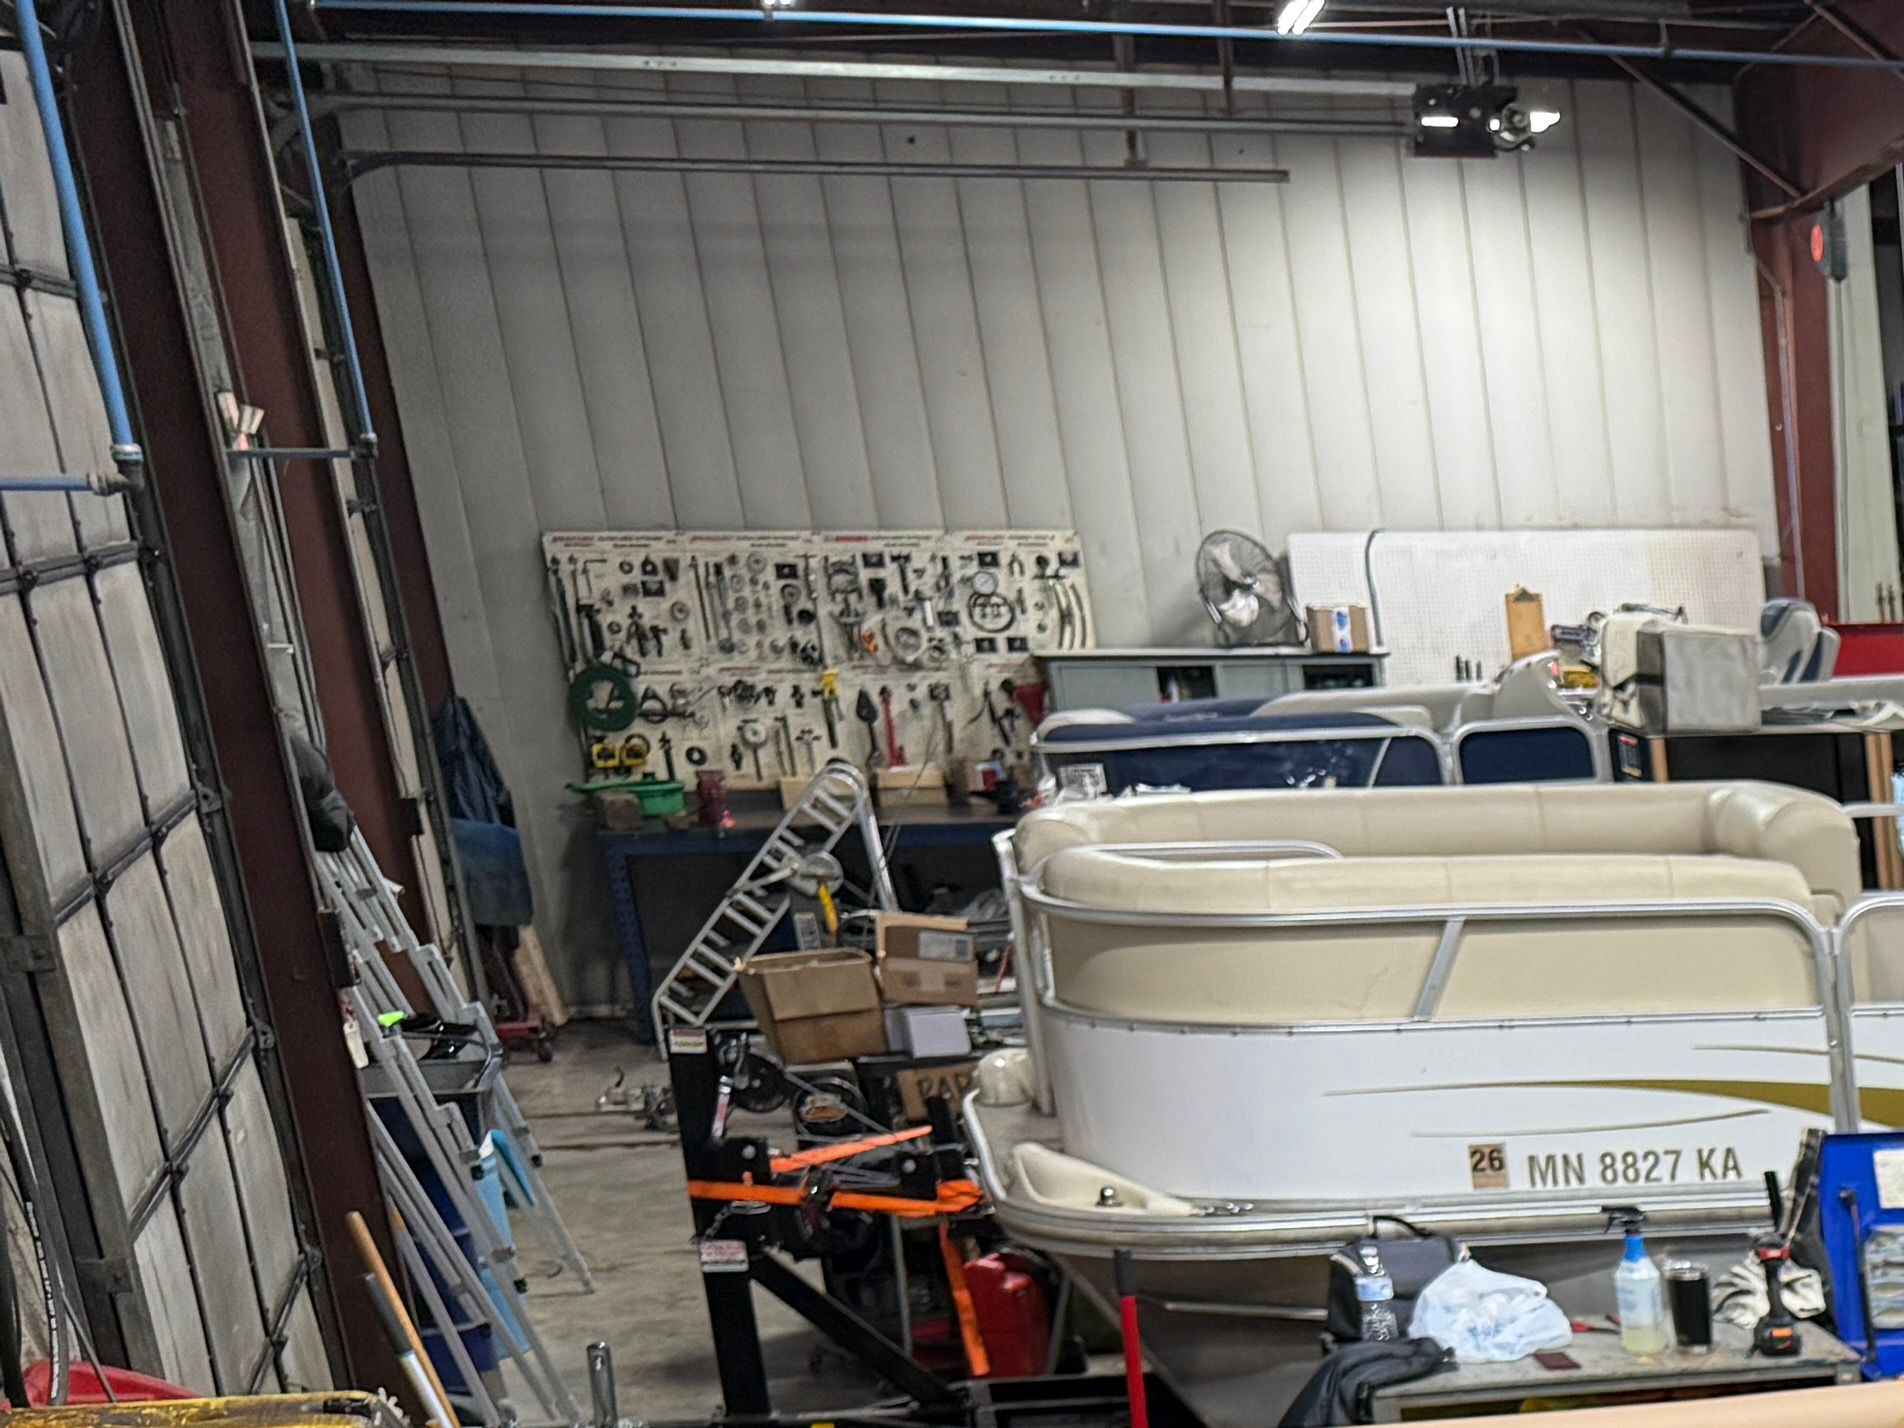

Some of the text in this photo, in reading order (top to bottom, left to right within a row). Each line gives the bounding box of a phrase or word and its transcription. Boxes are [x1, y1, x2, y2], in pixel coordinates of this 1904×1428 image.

[1470, 1148, 1505, 1173] 26
[1527, 1147, 1742, 1188] MN 8827 KA
